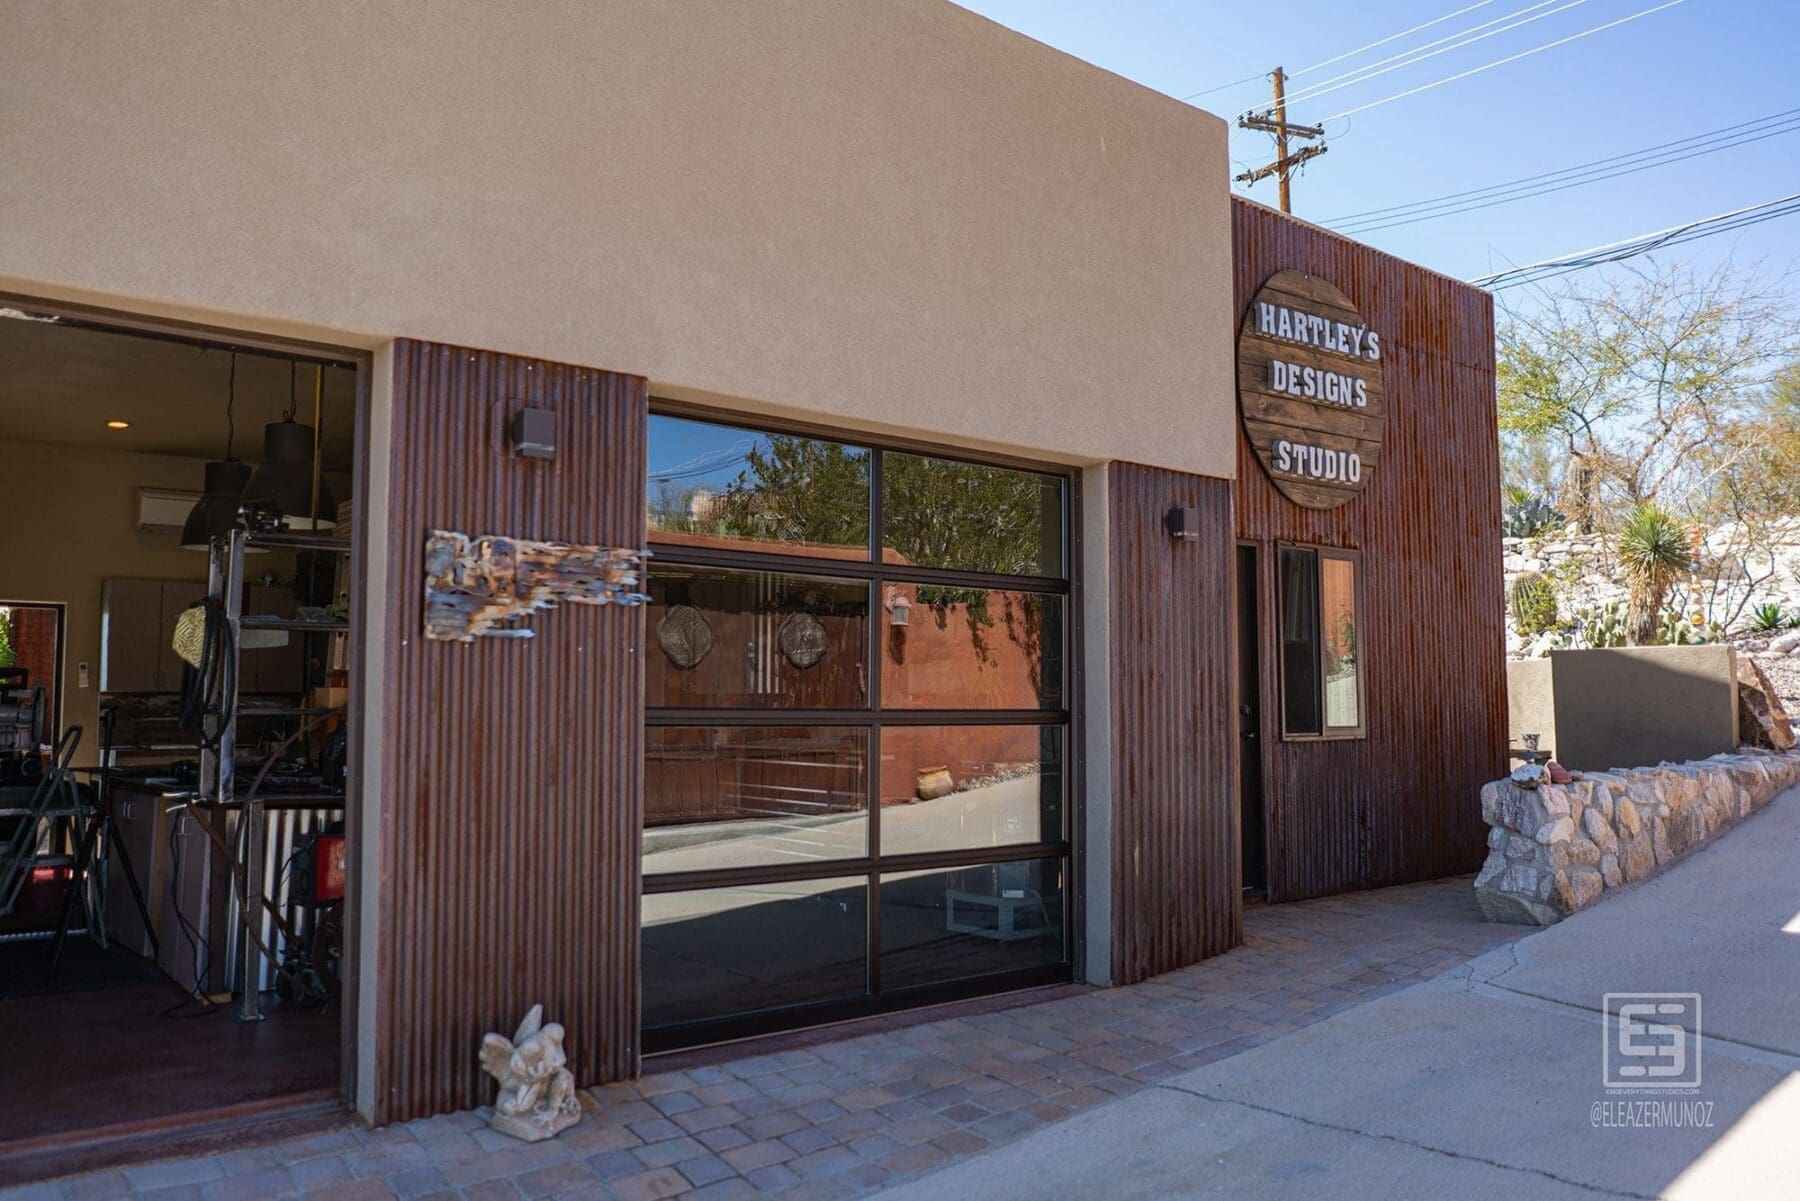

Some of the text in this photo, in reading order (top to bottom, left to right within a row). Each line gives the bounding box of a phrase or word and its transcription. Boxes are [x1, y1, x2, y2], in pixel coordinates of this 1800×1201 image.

[1259, 302, 1380, 361] HARTLEY'S
[1272, 360, 1367, 407] DESIGNS
[1278, 440, 1361, 483] STUDIO
